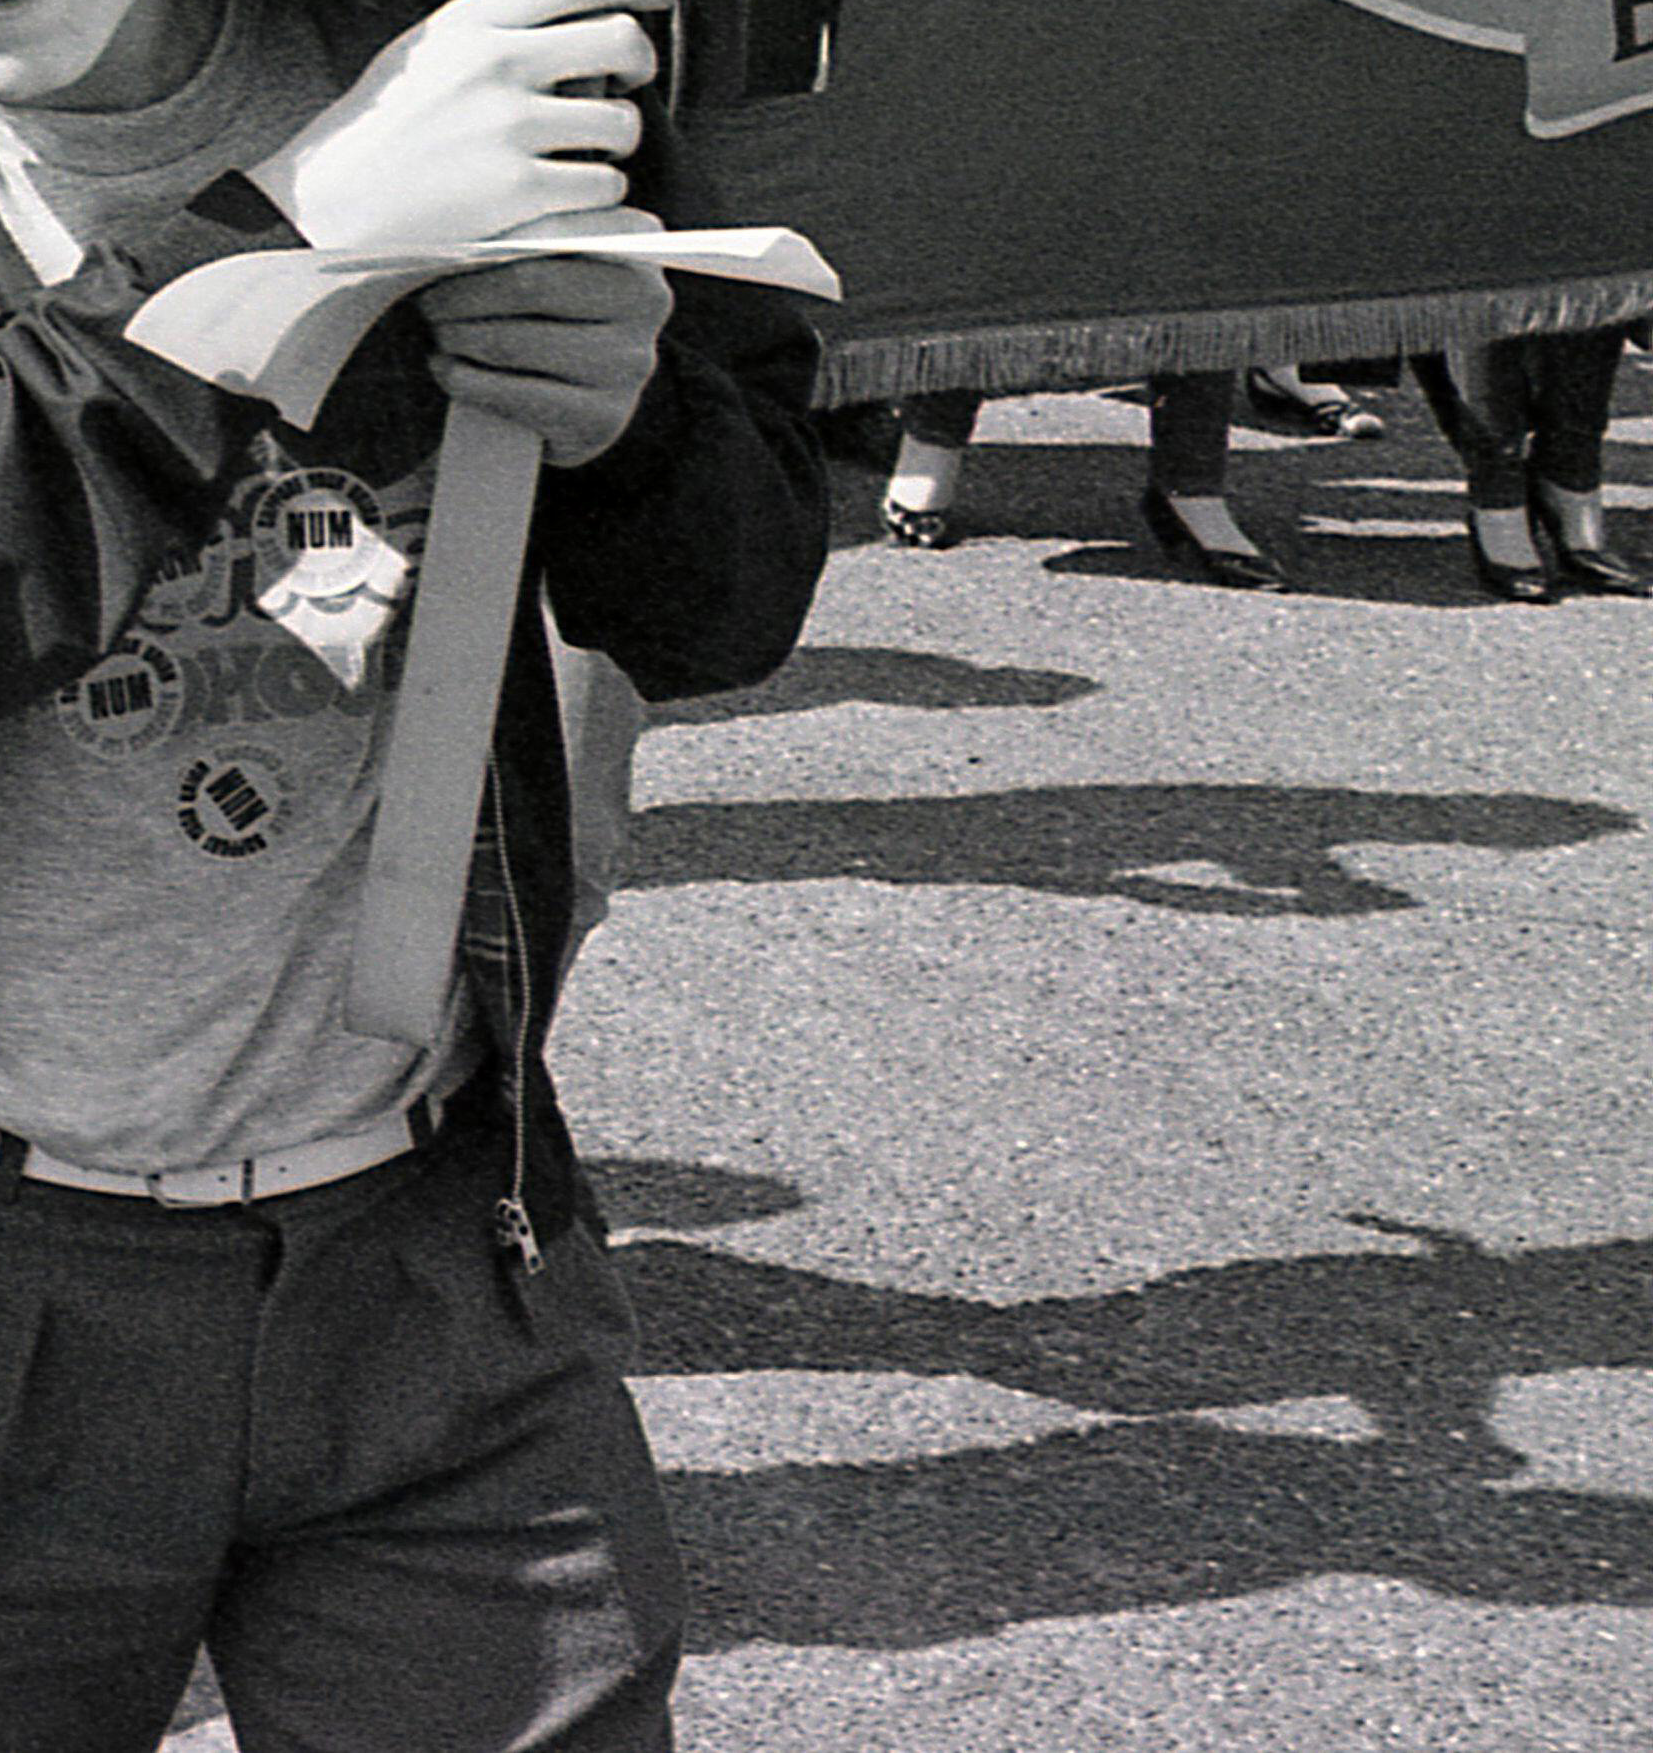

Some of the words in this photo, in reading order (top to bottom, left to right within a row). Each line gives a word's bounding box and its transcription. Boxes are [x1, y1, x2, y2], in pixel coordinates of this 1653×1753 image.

[287, 510, 353, 550] NUM
[87, 671, 154, 721] NUM
[205, 766, 269, 832] NUM
